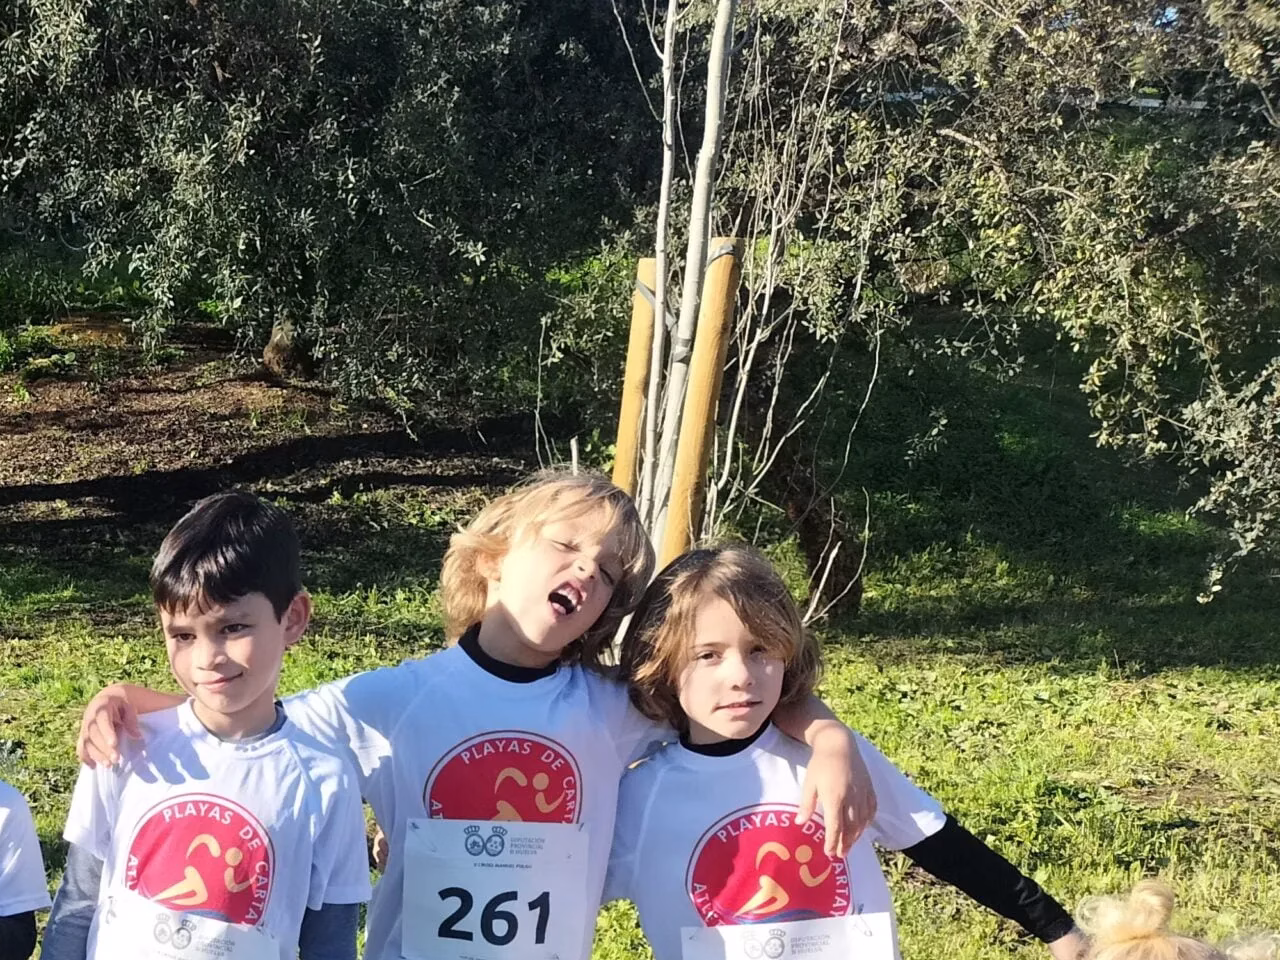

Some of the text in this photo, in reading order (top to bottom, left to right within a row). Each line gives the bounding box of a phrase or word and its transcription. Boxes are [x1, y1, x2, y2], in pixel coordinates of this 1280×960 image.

[461, 740, 576, 824] PLAYAS DE CART
[162, 802, 268, 922] PLAYAS DE CARTA
[717, 813, 790, 842] PLAYAS
[802, 822, 825, 842] DE
[437, 886, 550, 946] 261
